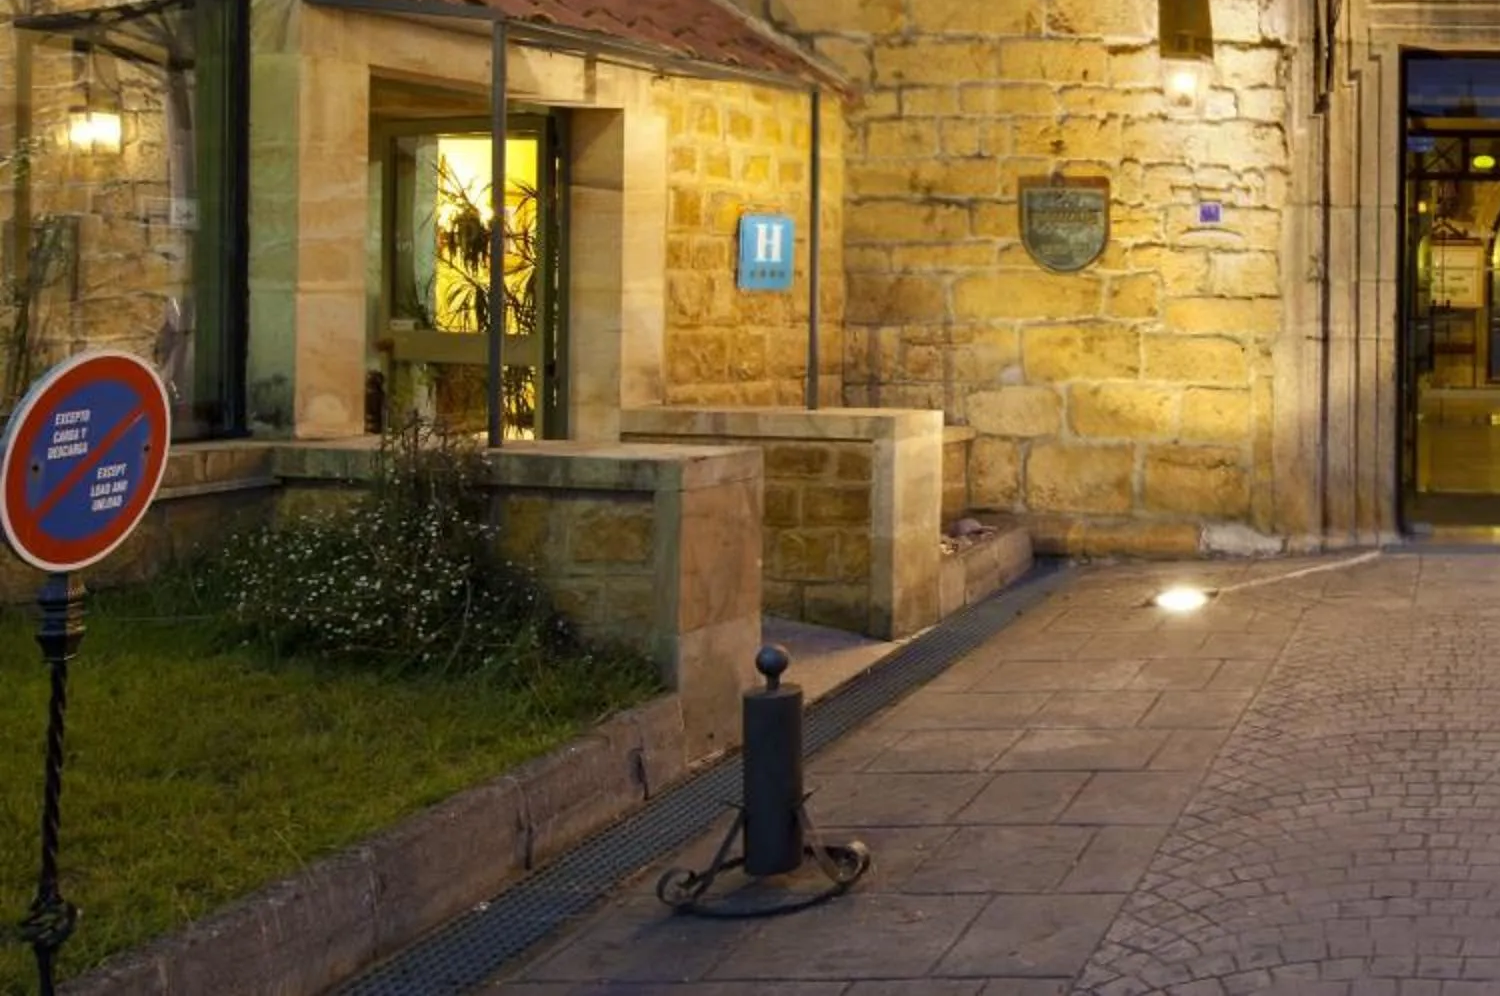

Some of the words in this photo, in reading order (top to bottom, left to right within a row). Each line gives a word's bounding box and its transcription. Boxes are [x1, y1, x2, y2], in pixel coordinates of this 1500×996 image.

[754, 223, 784, 262] H
[55, 409, 91, 425] EXCEPTO
[53, 429, 80, 444] CARGA
[81, 427, 88, 439] Y
[47, 442, 88, 460] DESCARGA
[97, 463, 128, 480] EXCEPT
[91, 483, 110, 497] LOAD
[111, 480, 129, 493] AND
[91, 495, 123, 512] UNLOAD
